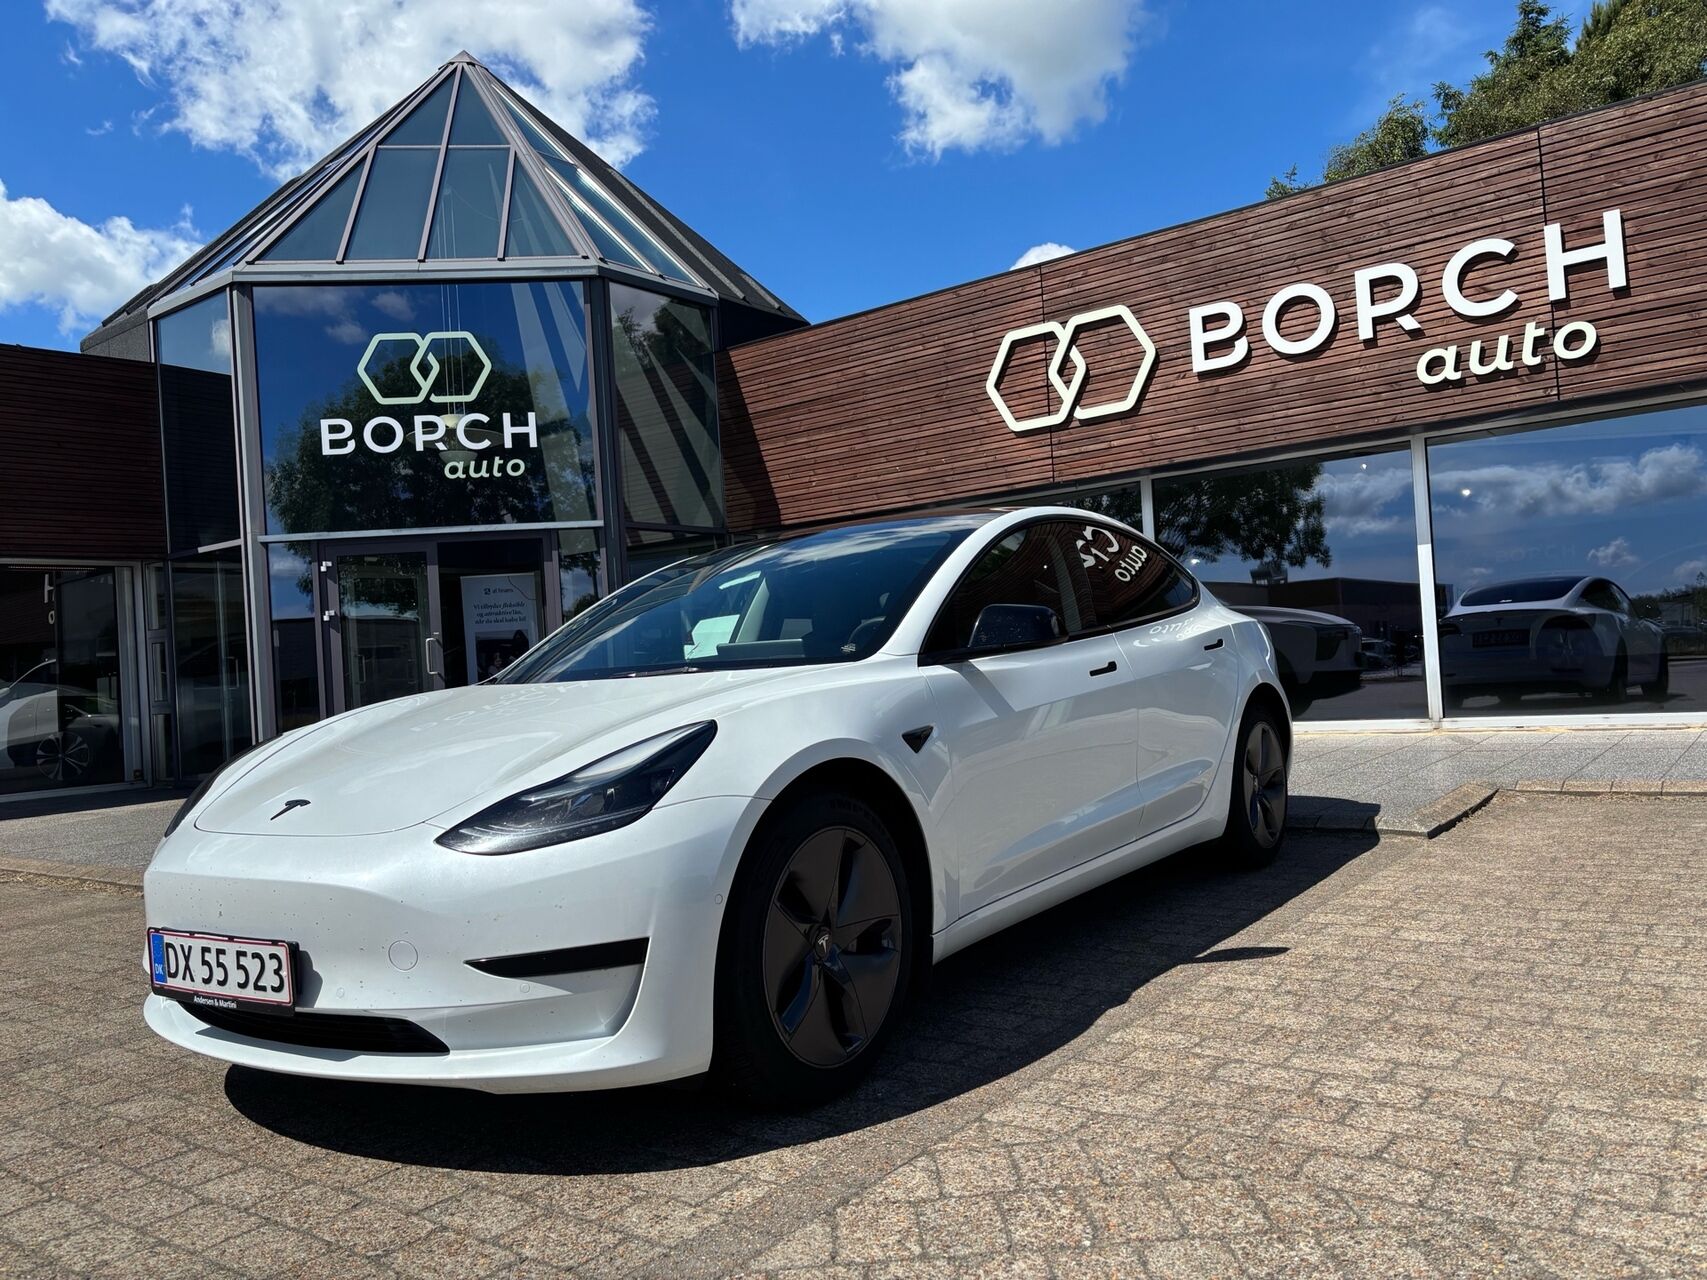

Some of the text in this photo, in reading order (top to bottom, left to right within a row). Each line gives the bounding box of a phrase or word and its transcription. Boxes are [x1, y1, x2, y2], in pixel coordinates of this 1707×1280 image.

[1189, 208, 1627, 373] BORCH
[1416, 320, 1597, 385] auto
[320, 411, 538, 456] BORCH
[444, 456, 525, 479] auto
[155, 963, 164, 975] DK
[165, 942, 285, 993] DX 55 523
[193, 995, 214, 1006] Andersen
[219, 999, 237, 1009] Martini
